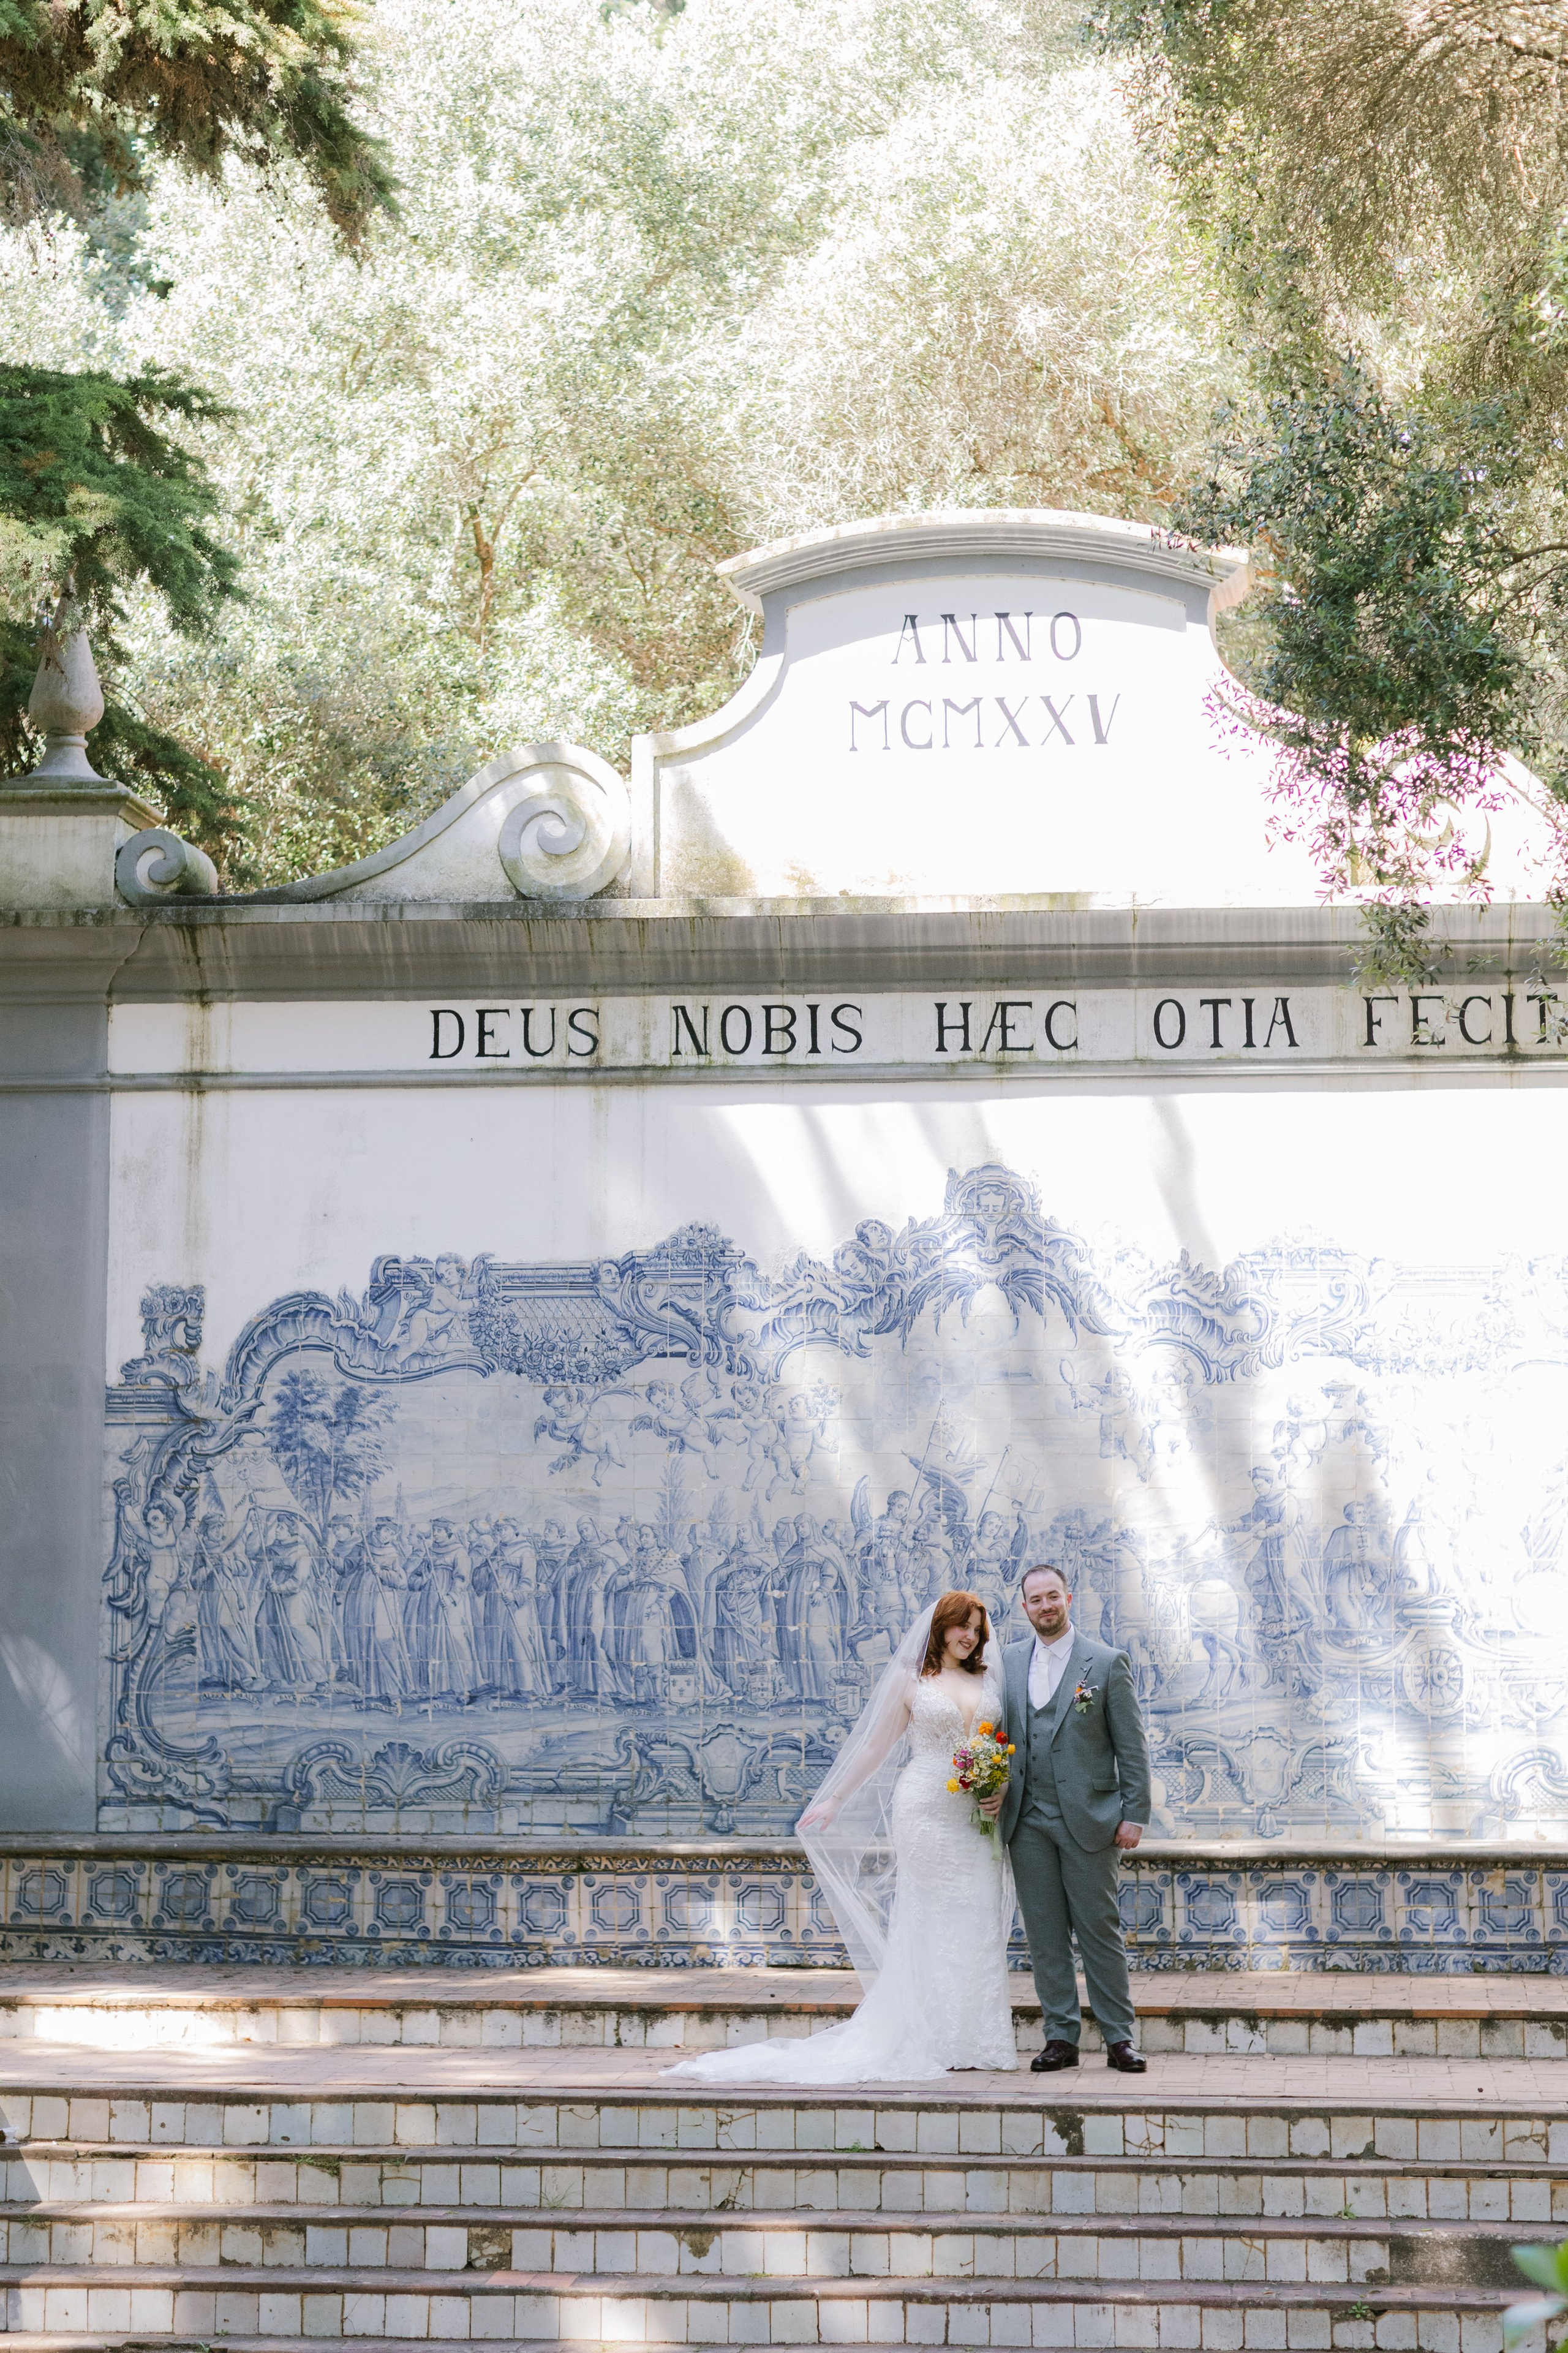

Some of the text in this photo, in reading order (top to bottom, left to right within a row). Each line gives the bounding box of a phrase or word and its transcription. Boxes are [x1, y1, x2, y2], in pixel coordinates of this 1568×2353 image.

[891, 611, 1082, 664] ANNO
[849, 693, 1121, 752] MCMXXV
[429, 995, 1558, 1059] DEUS NOBIS HÆC OTIA FECIT
